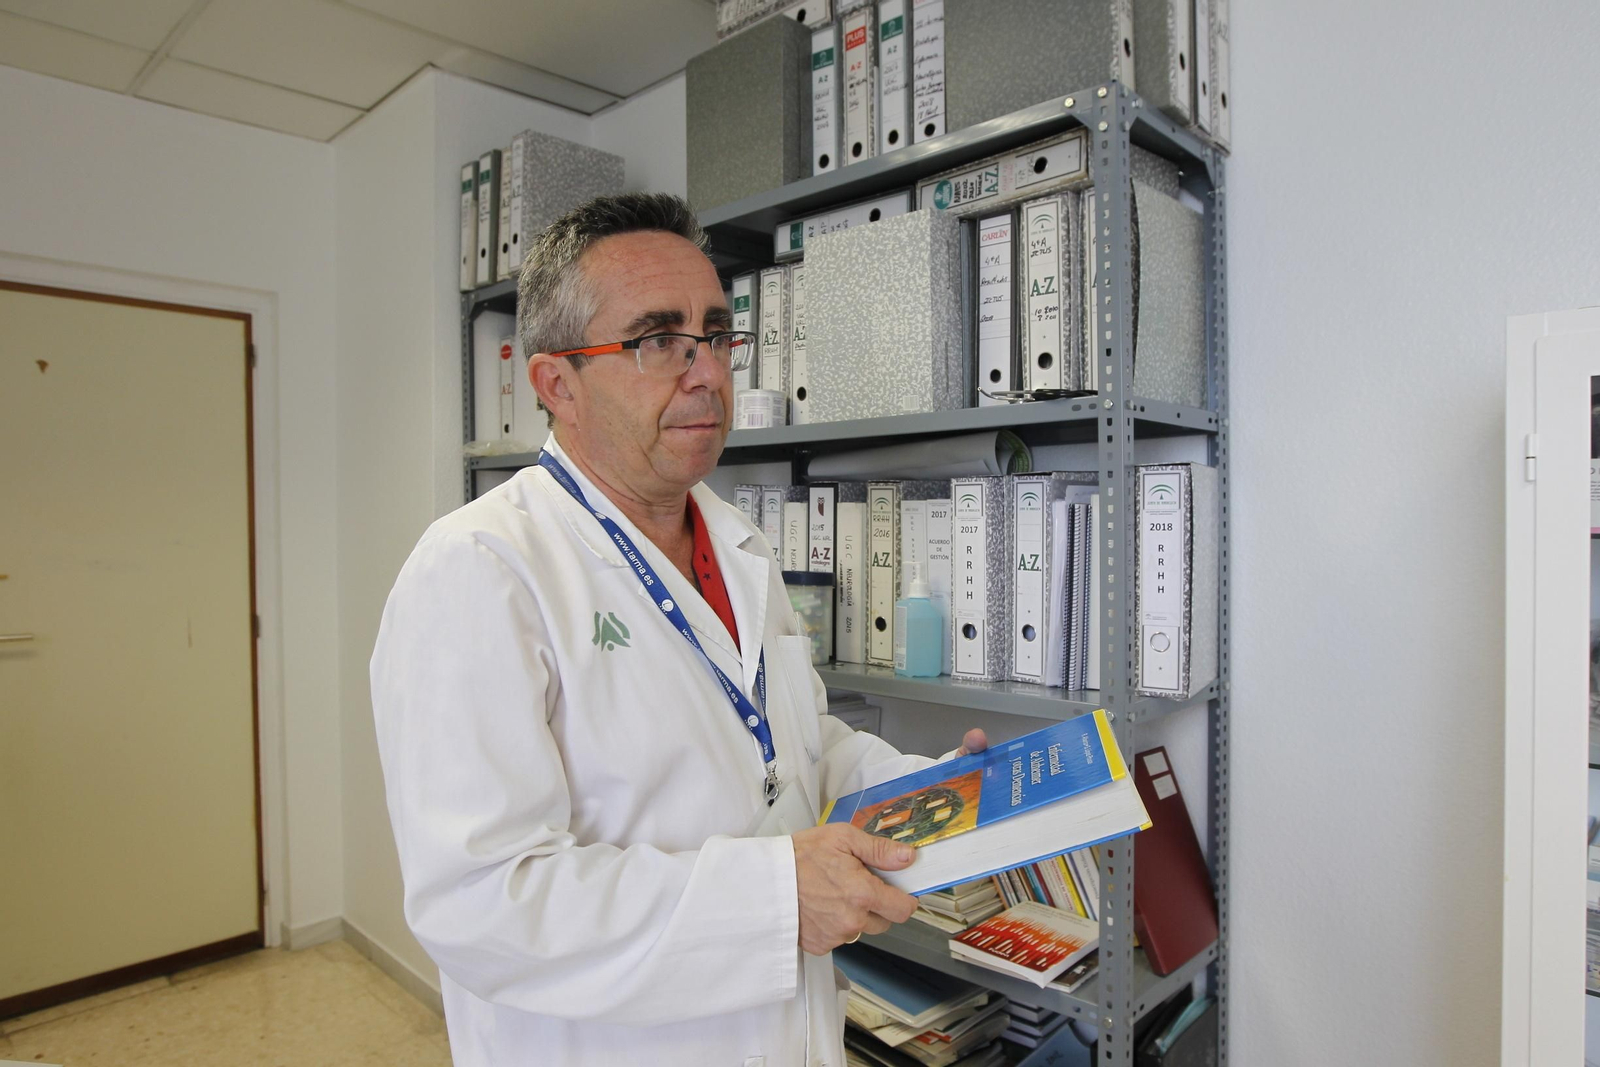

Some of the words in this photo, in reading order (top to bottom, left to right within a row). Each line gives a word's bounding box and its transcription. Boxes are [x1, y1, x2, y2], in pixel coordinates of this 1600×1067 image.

[847, 28, 866, 41] PLUS
[960, 526, 978, 534] 2017
[1150, 523, 1173, 531] 2018
[873, 528, 891, 538] 2016
[613, 532, 654, 586] www.tarma.es
[811, 547, 831, 560] A-Z
[1030, 750, 1044, 758] de
[1047, 743, 1066, 776] Enfermedad
